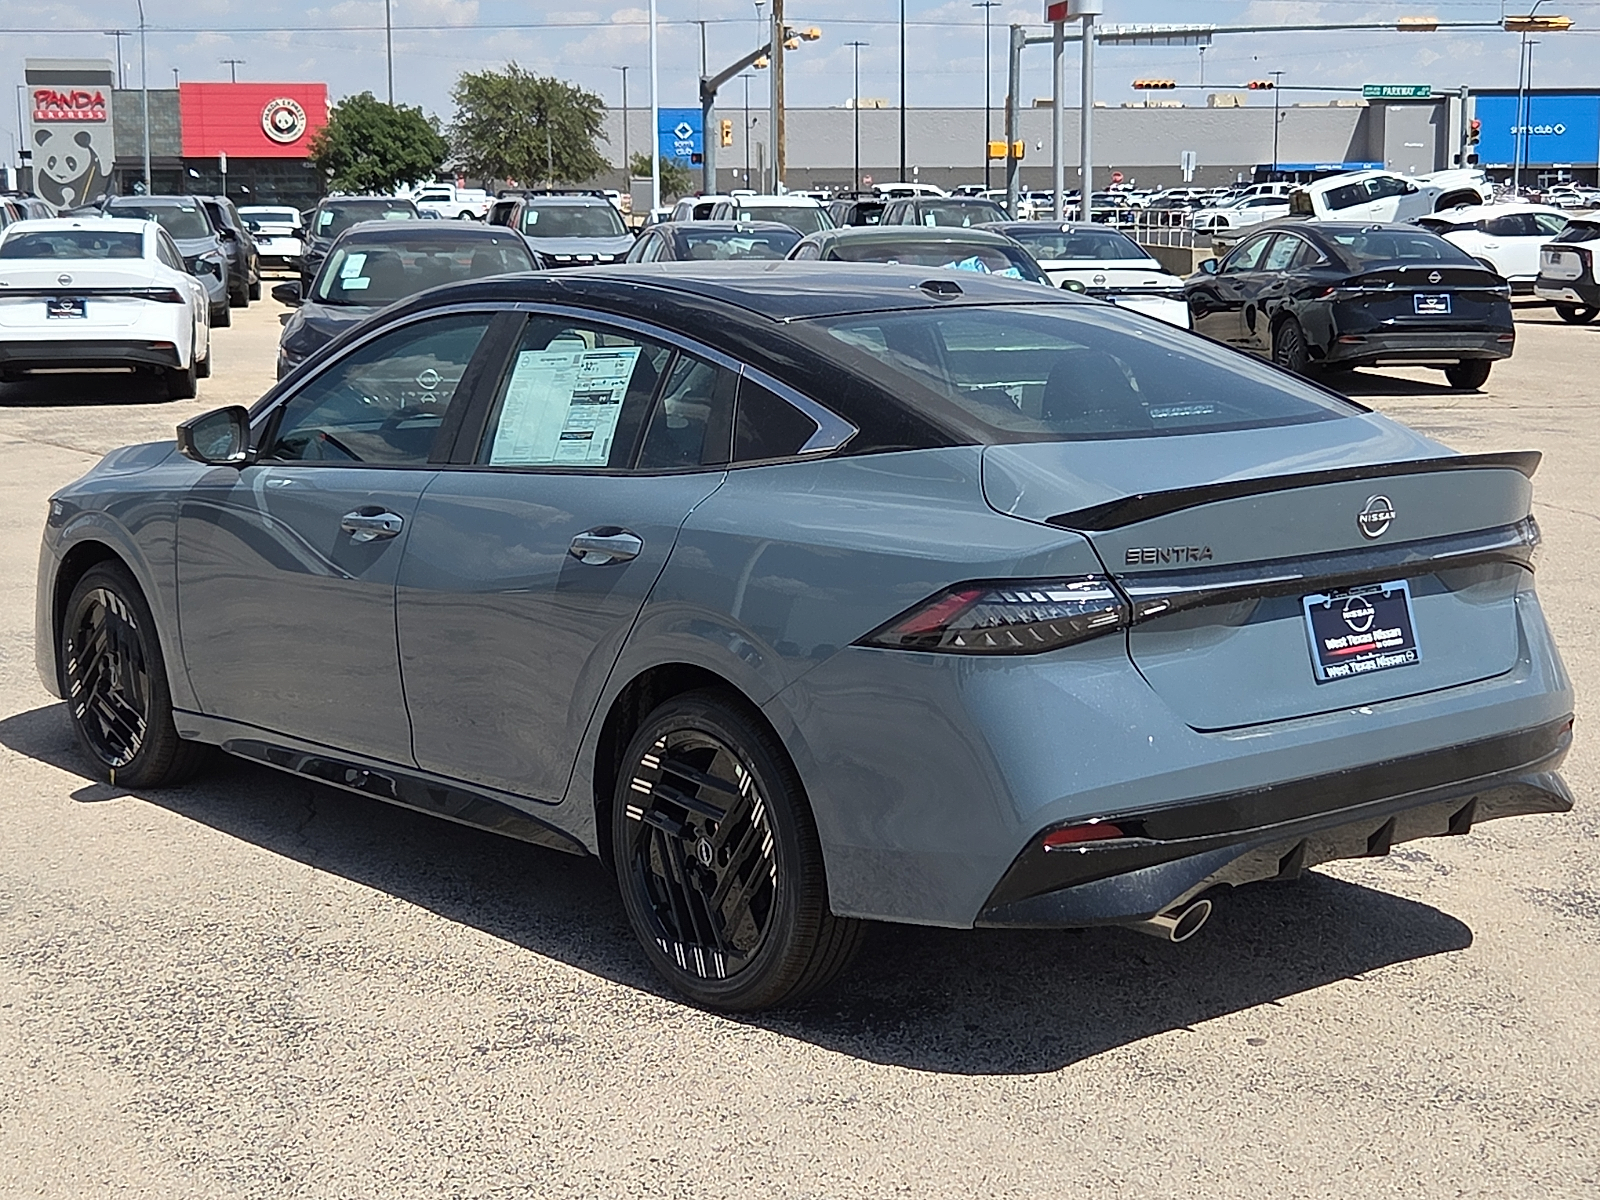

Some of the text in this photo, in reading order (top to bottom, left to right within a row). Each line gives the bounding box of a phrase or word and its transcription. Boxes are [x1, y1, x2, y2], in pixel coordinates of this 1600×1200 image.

[1382, 87, 1415, 95] PARKWAY
[33, 89, 106, 111] PANDA
[37, 111, 104, 119] EXPRESS
[1359, 511, 1396, 522] NISSAN
[1124, 545, 1214, 566] SENTRA
[1342, 607, 1375, 620] NISSAN
[1324, 627, 1402, 651] West Texas Nissan
[1326, 663, 1351, 678] West
[1348, 659, 1377, 673] Texas
[1375, 654, 1407, 668] Nissan
